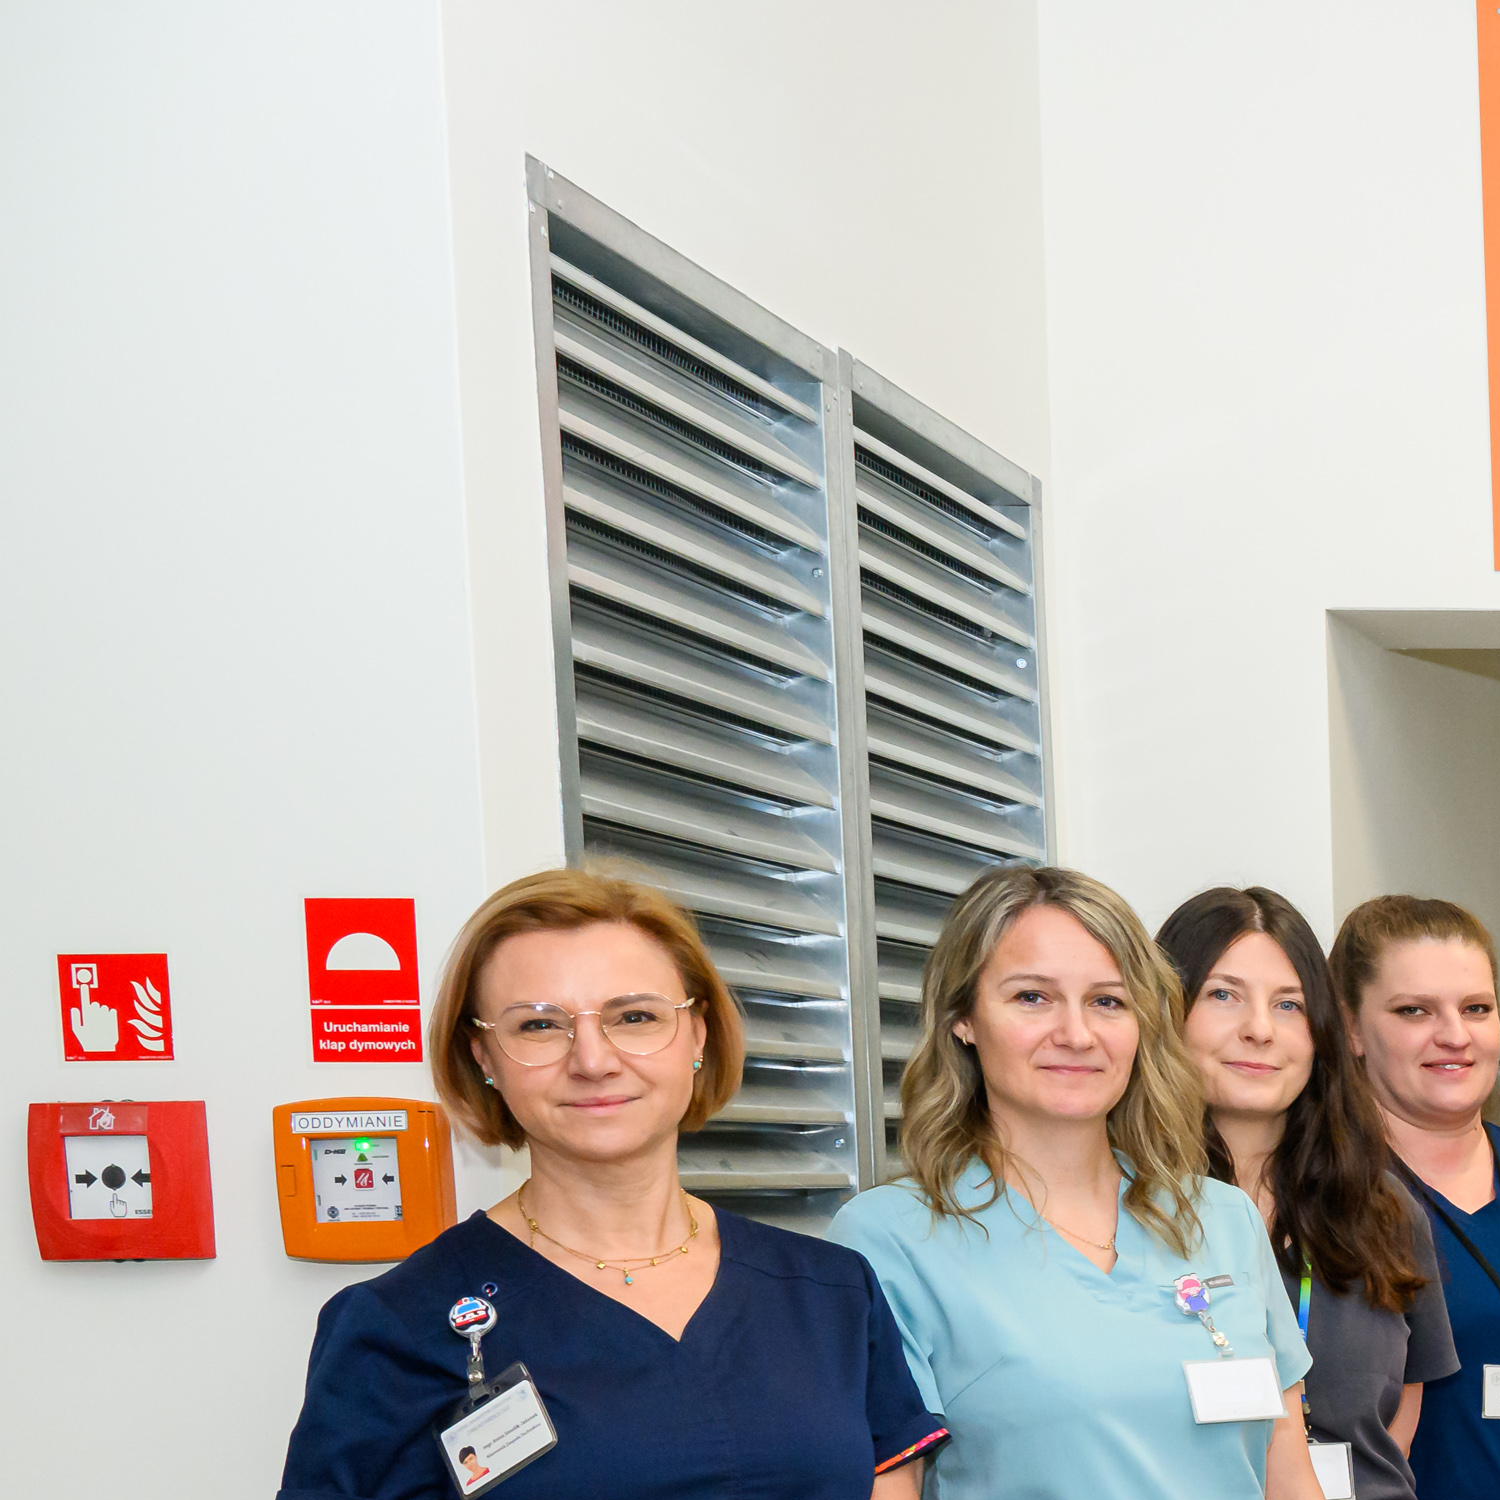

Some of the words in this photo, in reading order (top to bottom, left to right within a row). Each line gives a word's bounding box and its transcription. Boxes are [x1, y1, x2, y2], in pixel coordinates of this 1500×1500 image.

[323, 1021, 410, 1033] Uruchamianie
[319, 1039, 346, 1052] klap
[349, 1039, 416, 1052] dymowych
[298, 1115, 403, 1129] ODDYMIANIE
